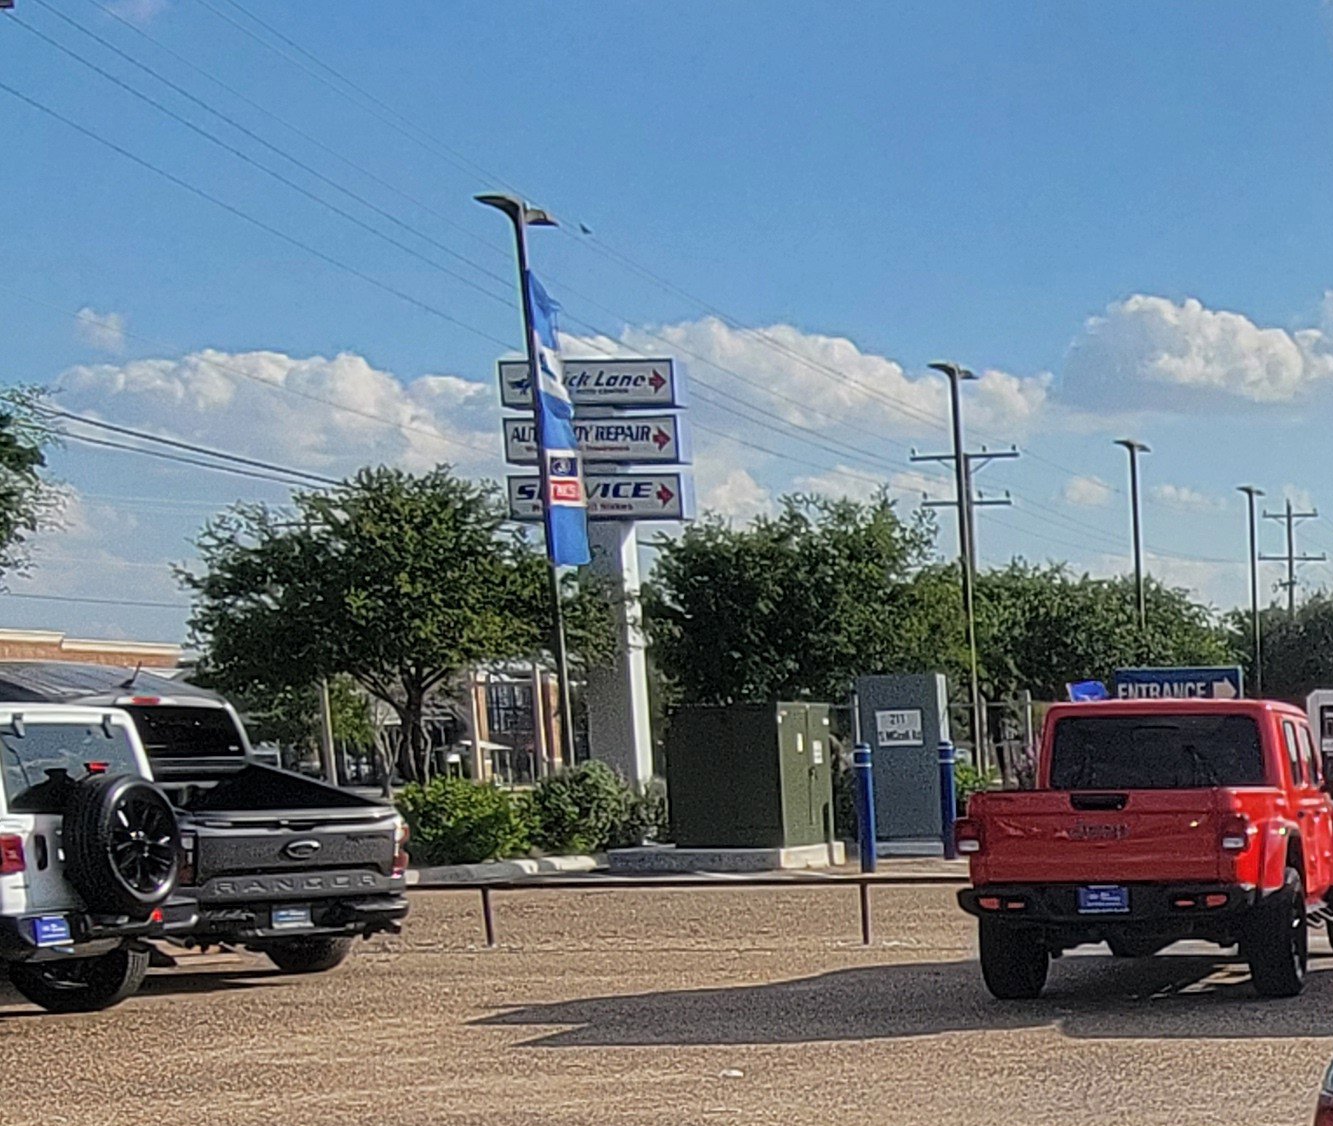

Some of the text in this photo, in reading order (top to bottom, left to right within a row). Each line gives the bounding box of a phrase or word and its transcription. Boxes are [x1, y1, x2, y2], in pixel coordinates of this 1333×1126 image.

[562, 370, 646, 387] ick Lane
[511, 427, 538, 442] AUT
[595, 425, 651, 442] REPAIR
[515, 481, 653, 500] SVICE
[1117, 682, 1206, 699] ENTRANCE
[214, 875, 377, 896] RANGER
